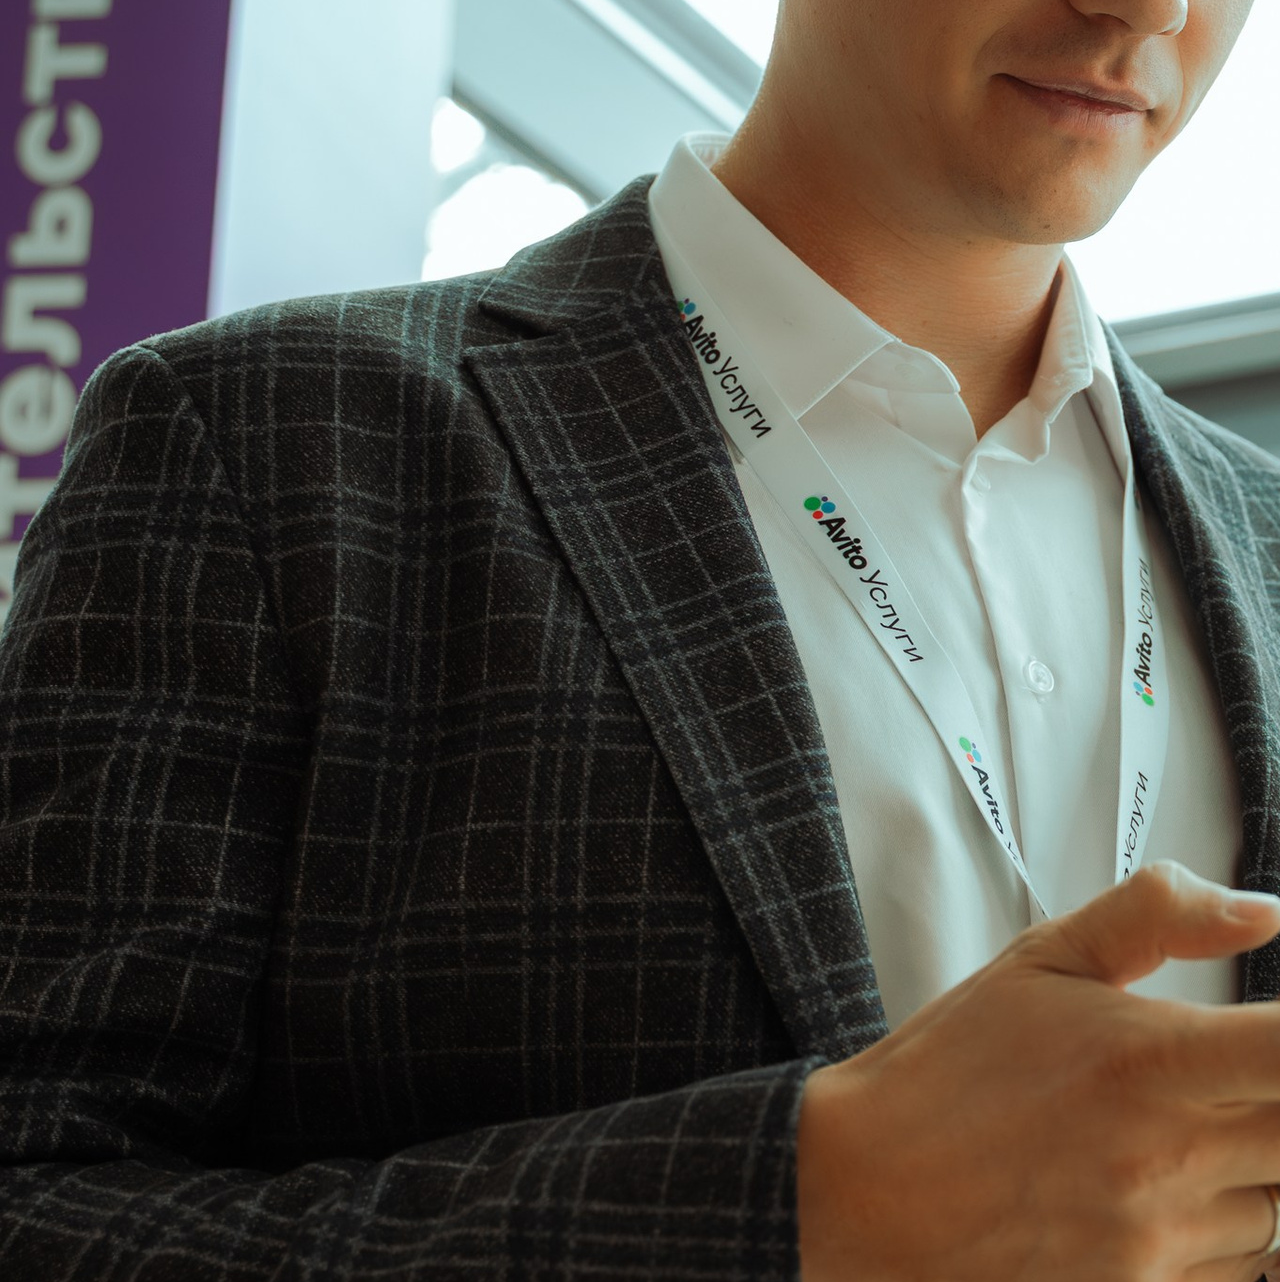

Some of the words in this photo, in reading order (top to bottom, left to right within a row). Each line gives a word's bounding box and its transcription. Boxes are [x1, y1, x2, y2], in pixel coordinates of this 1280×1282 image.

[684, 315, 721, 365] Avito
[712, 356, 771, 438] Услуги
[818, 517, 868, 569] Avito
[859, 569, 924, 662] Услуги
[1137, 557, 1154, 632] Услуги
[1133, 632, 1153, 688] Avito
[971, 764, 1004, 835] Avito
[1124, 771, 1148, 867] Услуги
